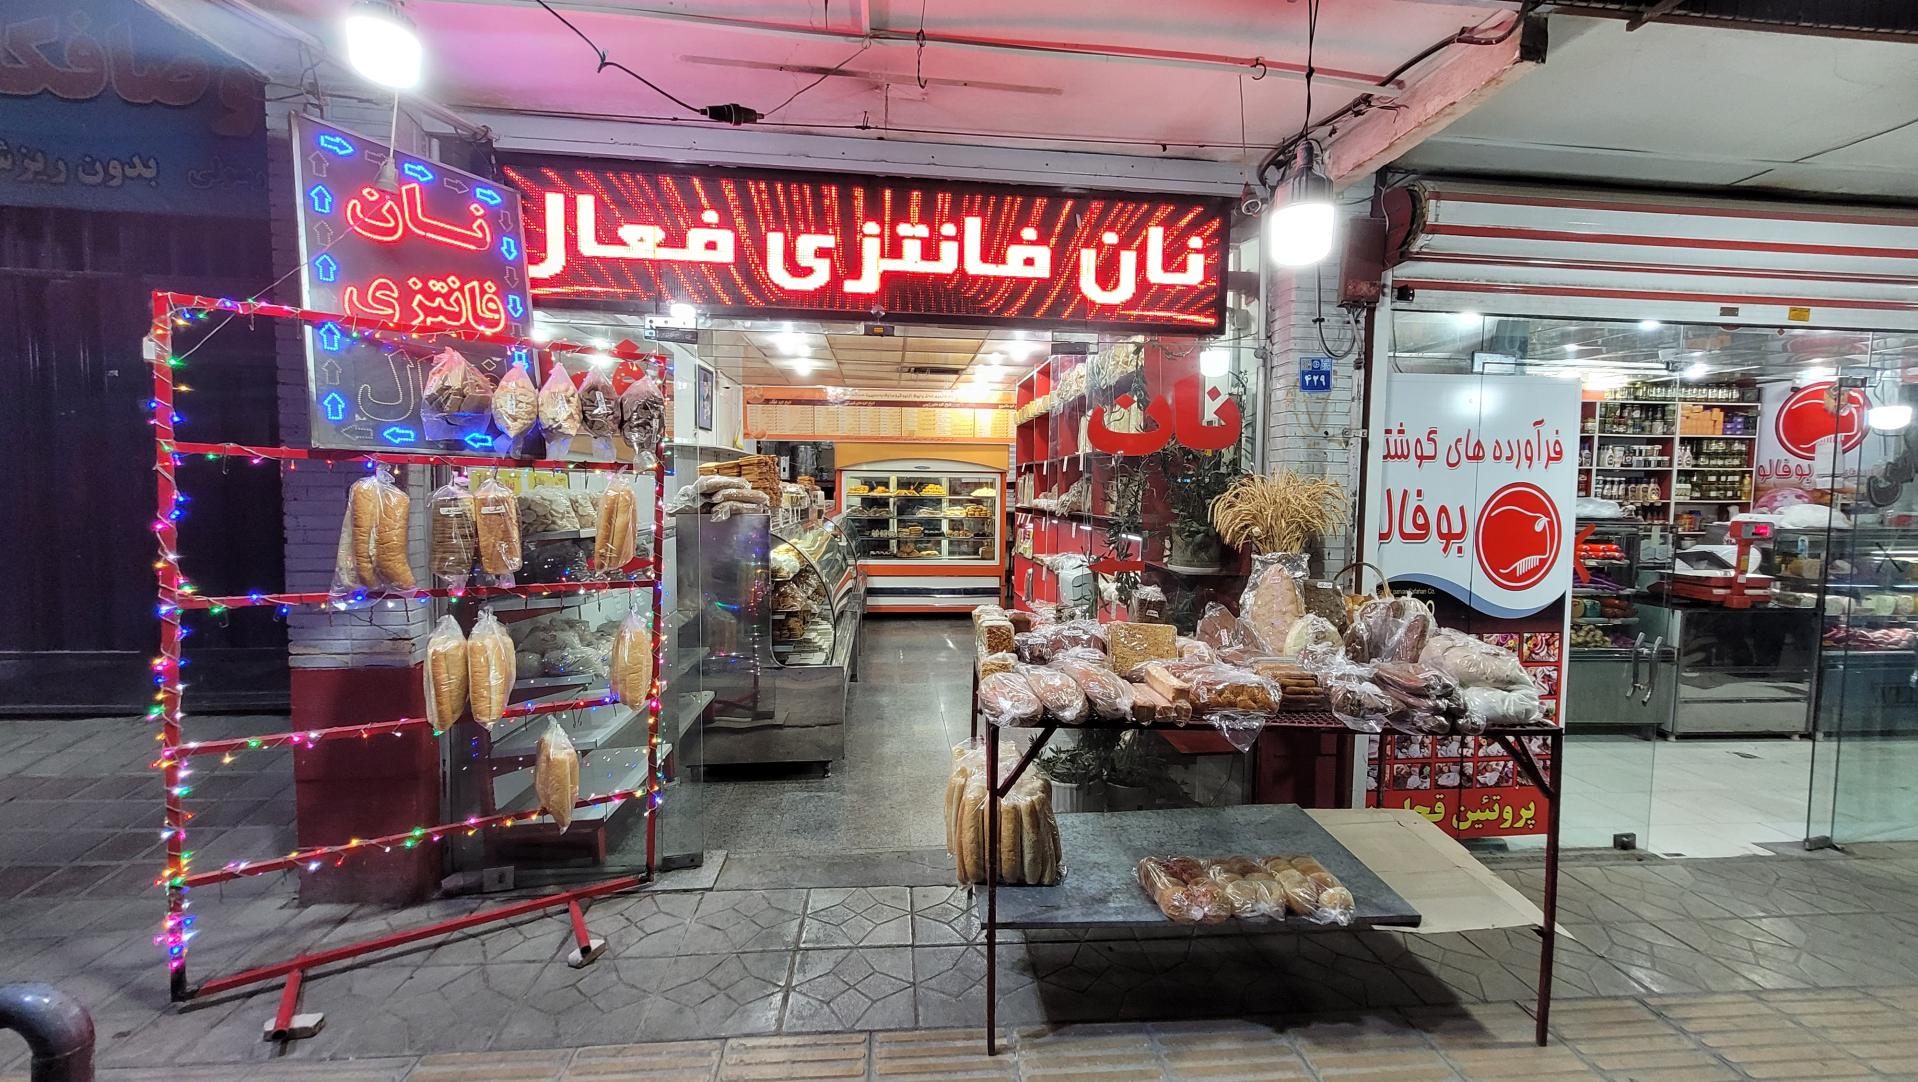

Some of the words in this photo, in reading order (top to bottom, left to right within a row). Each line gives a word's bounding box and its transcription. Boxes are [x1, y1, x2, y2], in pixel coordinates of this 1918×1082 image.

[77, 153, 160, 189] بدون
[346, 182, 492, 251] نان
[528, 190, 735, 280] فعال
[766, 214, 1051, 294] فانتزی
[1080, 224, 1206, 304] نان
[343, 276, 506, 334] فانتزی
[1304, 374, 1326, 387] ۴۲۹
[1087, 374, 1242, 457] نان
[1445, 428, 1487, 470] های
[1492, 418, 1564, 470] فرآورده
[1757, 458, 1815, 485] بوفالو
[1451, 794, 1536, 830] پروتئین
